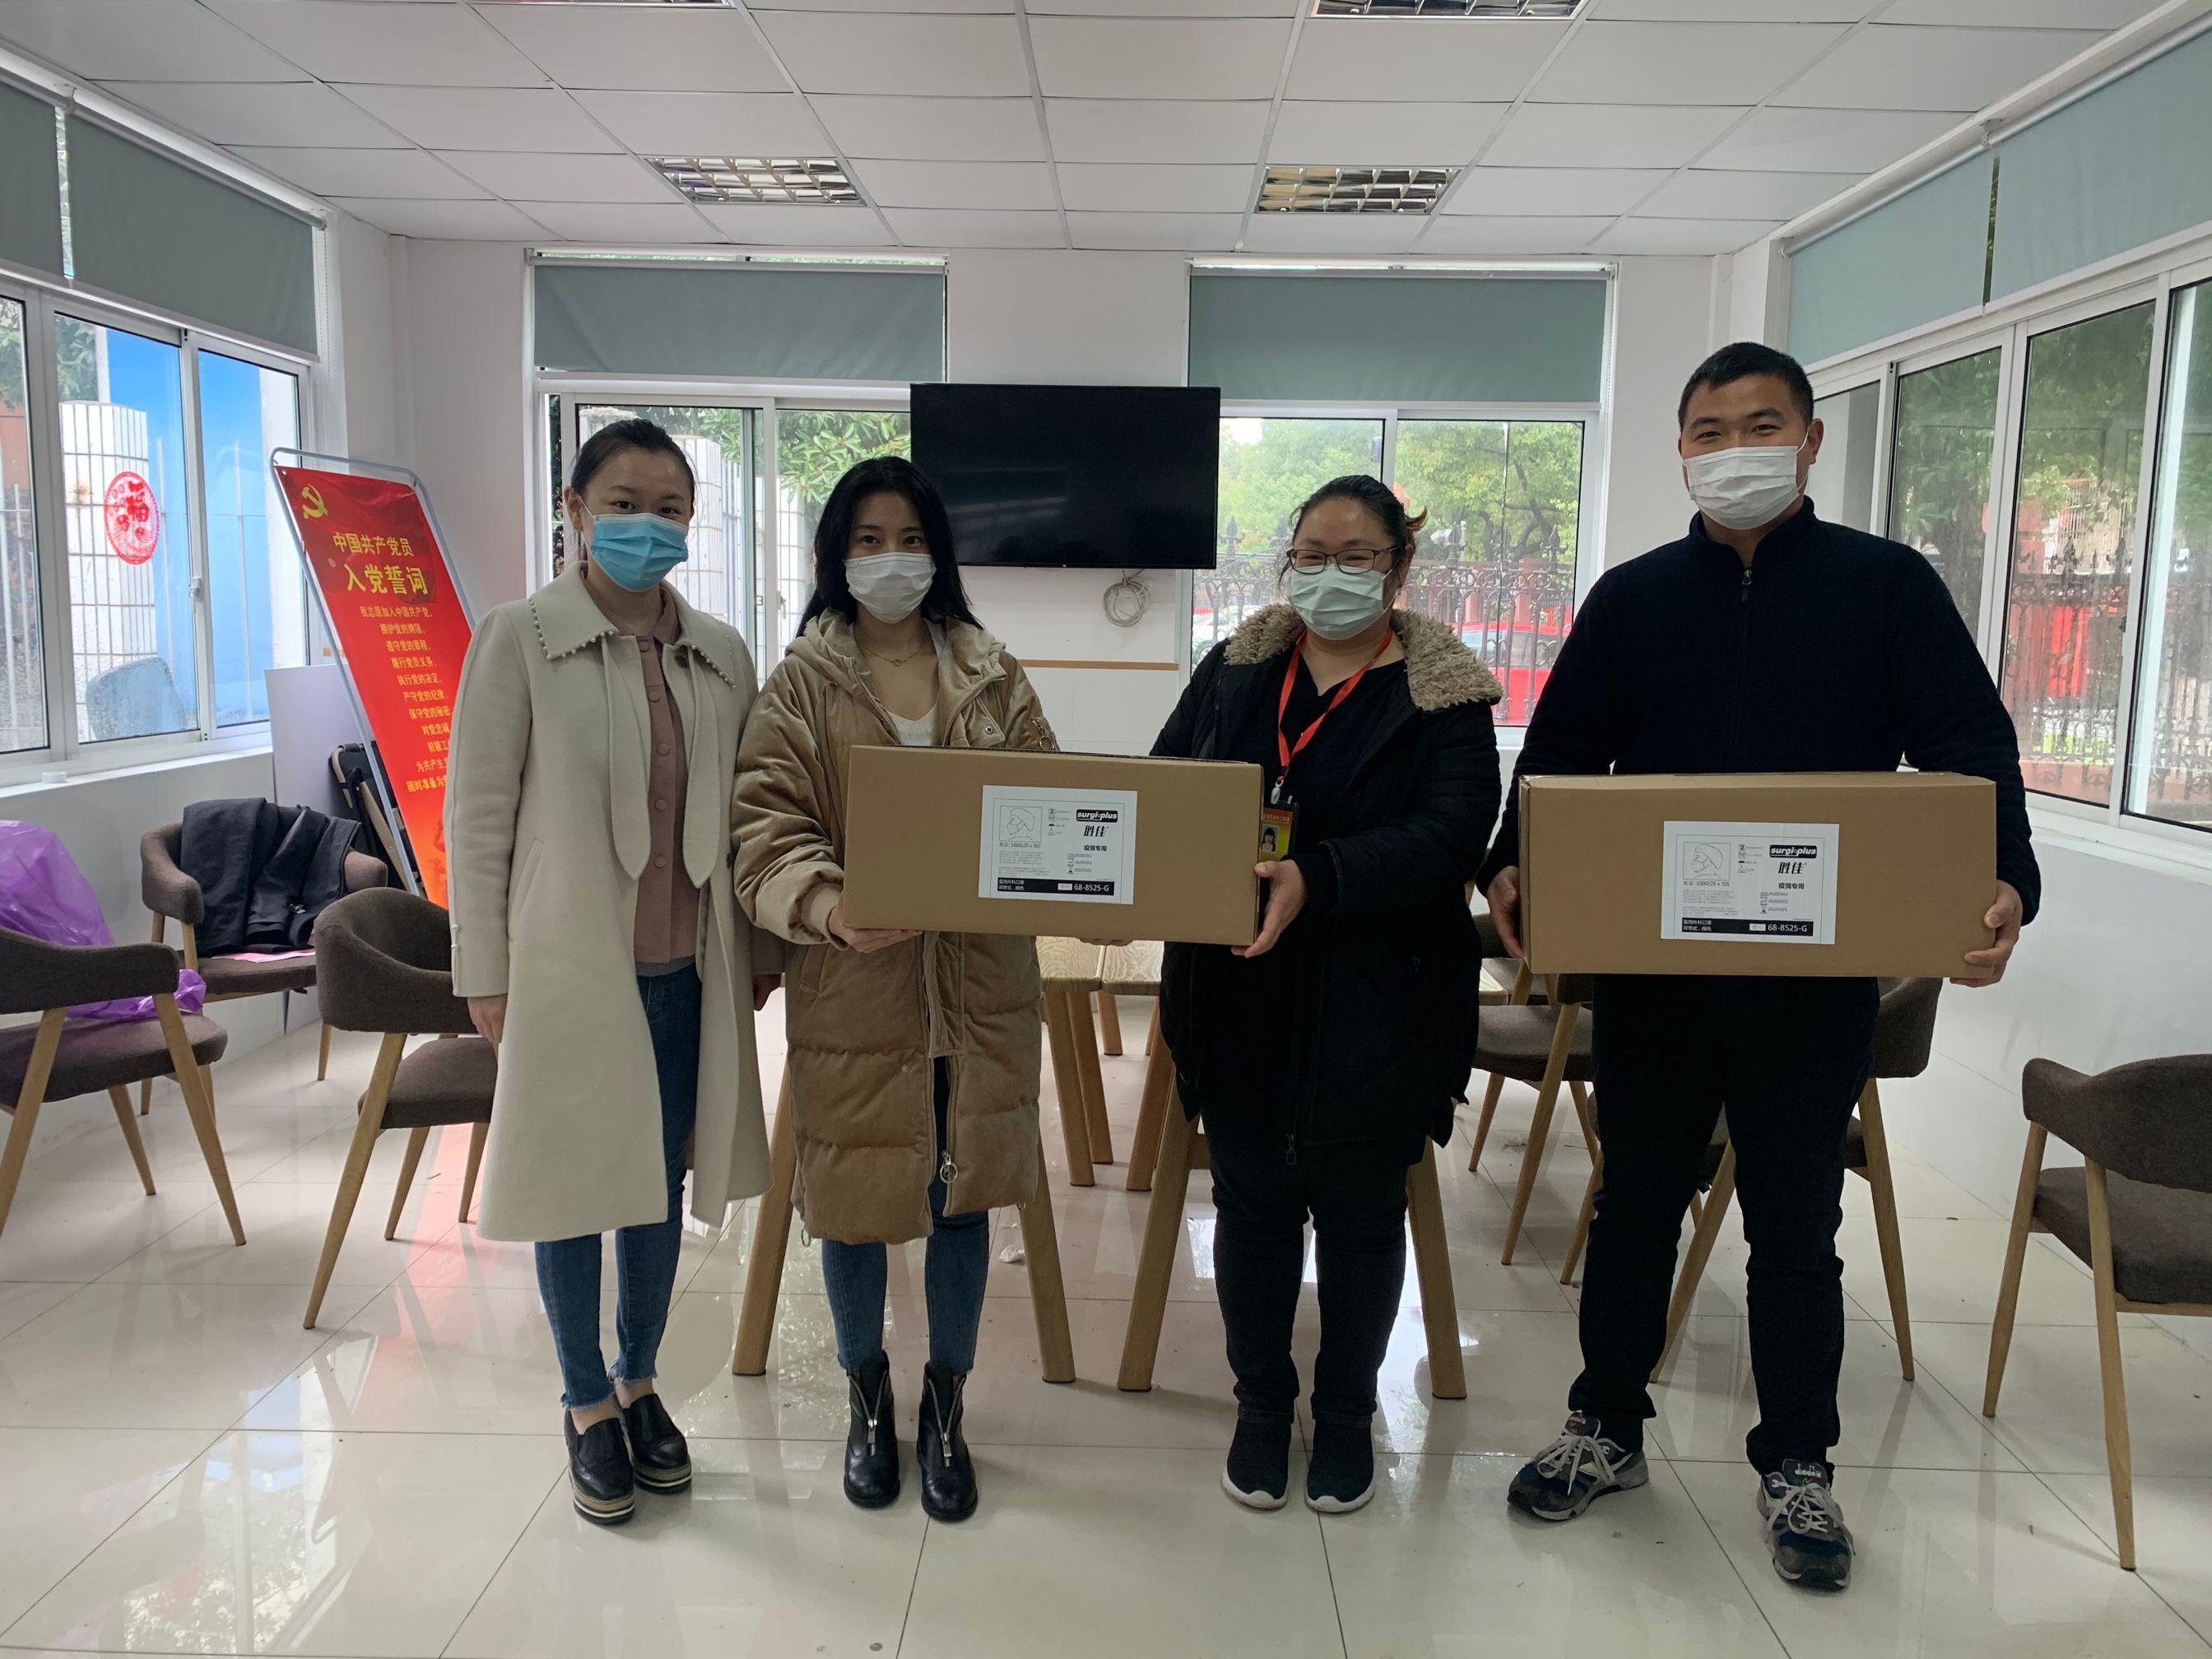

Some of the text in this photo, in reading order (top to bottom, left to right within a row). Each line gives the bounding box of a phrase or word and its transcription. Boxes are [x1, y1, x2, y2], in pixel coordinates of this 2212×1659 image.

[332, 532, 414, 556] 中国共产党员
[344, 563, 428, 594] 入党誓词
[1074, 883, 1109, 892] 68-8525-G
[1768, 923, 1808, 932] 68-8525-G
